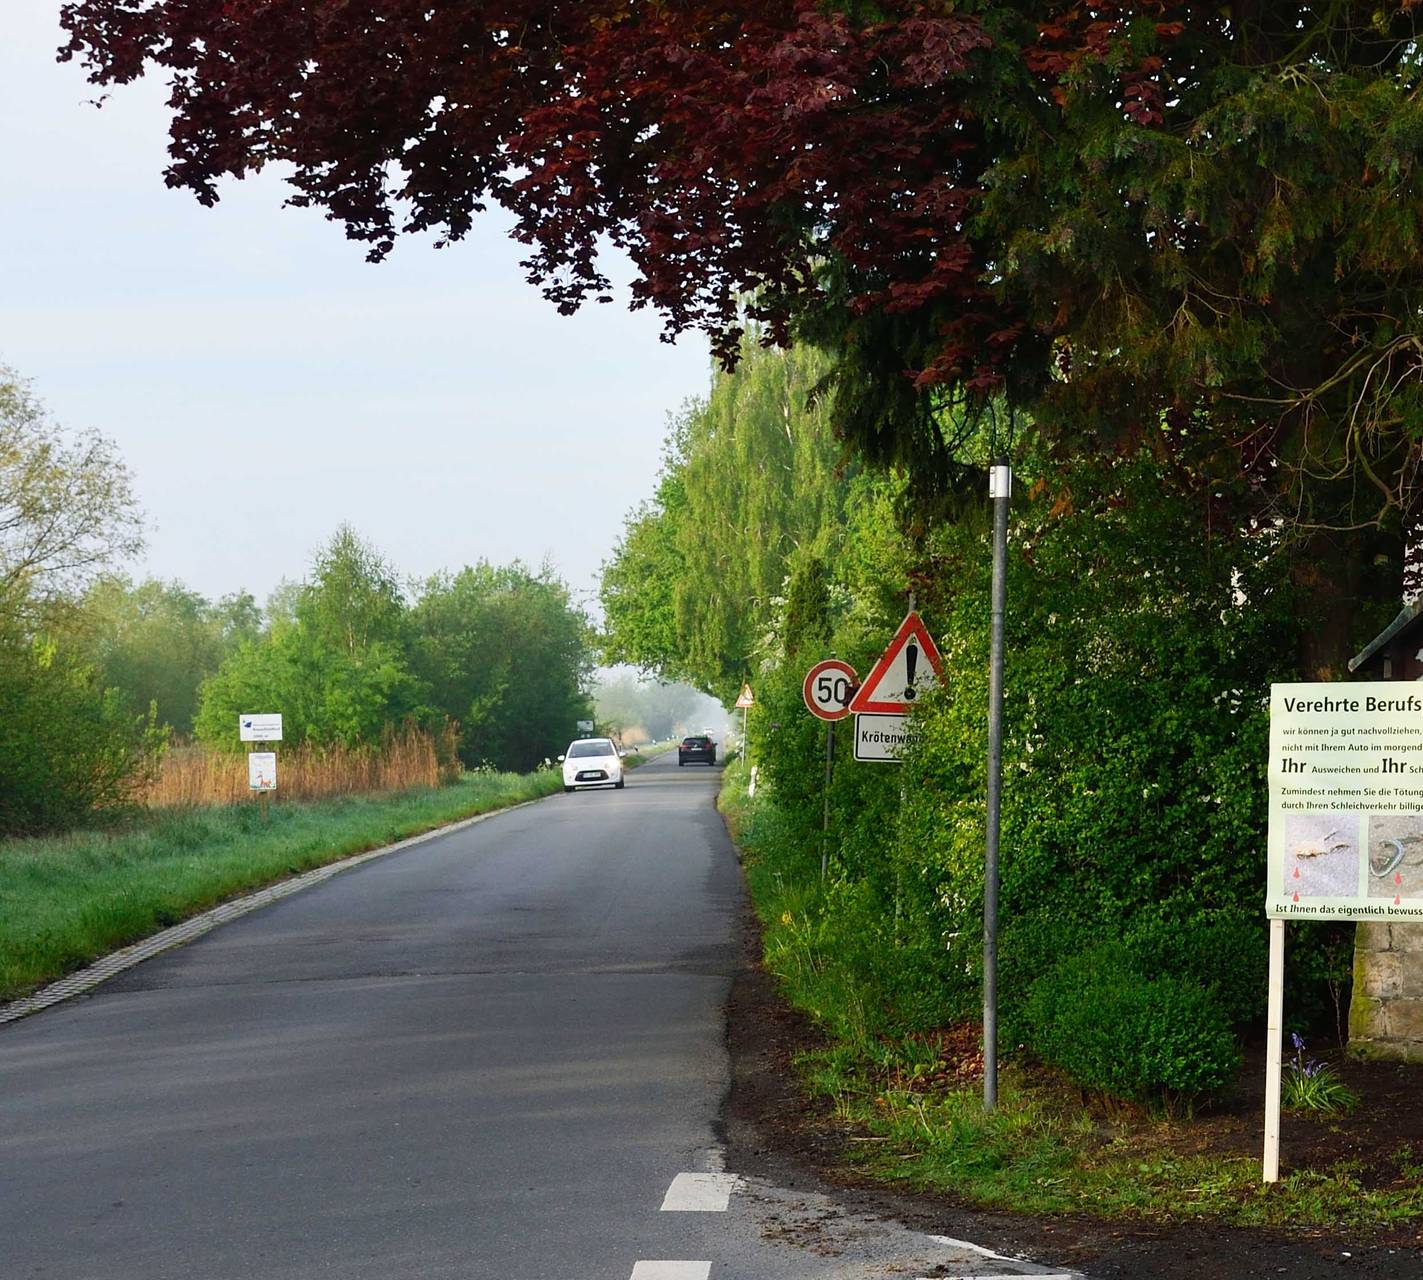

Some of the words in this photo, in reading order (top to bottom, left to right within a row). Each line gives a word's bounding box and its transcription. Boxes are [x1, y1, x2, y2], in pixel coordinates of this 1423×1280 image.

[817, 677, 848, 704] 50
[1284, 697, 1359, 712] Verehrte
[1282, 727, 1295, 735] wir
[1297, 727, 1329, 735] können
[1331, 727, 1338, 737] ja
[1340, 727, 1355, 737] gut
[1357, 725, 1422, 735] nachvollziehen,
[1281, 743, 1302, 751] nicht
[1304, 743, 1319, 751] mit
[1321, 743, 1345, 751] Ihrem
[1347, 743, 1368, 751] Auto
[1370, 743, 1381, 751] im
[1281, 757, 1307, 774] Ihr
[1311, 765, 1361, 774] Ausweichen
[1363, 765, 1379, 774] und
[1381, 757, 1407, 773] Ihr
[1281, 786, 1325, 795] Zumindest
[1327, 787, 1361, 796] nehmen
[1364, 787, 1376, 796] Sie
[1378, 787, 1391, 796] die
[1394, 787, 1423, 798] Tötung
[1281, 800, 1304, 809] durch
[1306, 800, 1328, 809] Ihren
[1331, 801, 1396, 810] Schleichverkehr
[1276, 904, 1287, 913] Ist
[1290, 905, 1317, 914] Ihnen
[1319, 905, 1336, 914] das
[1338, 905, 1385, 917] eigentlich
